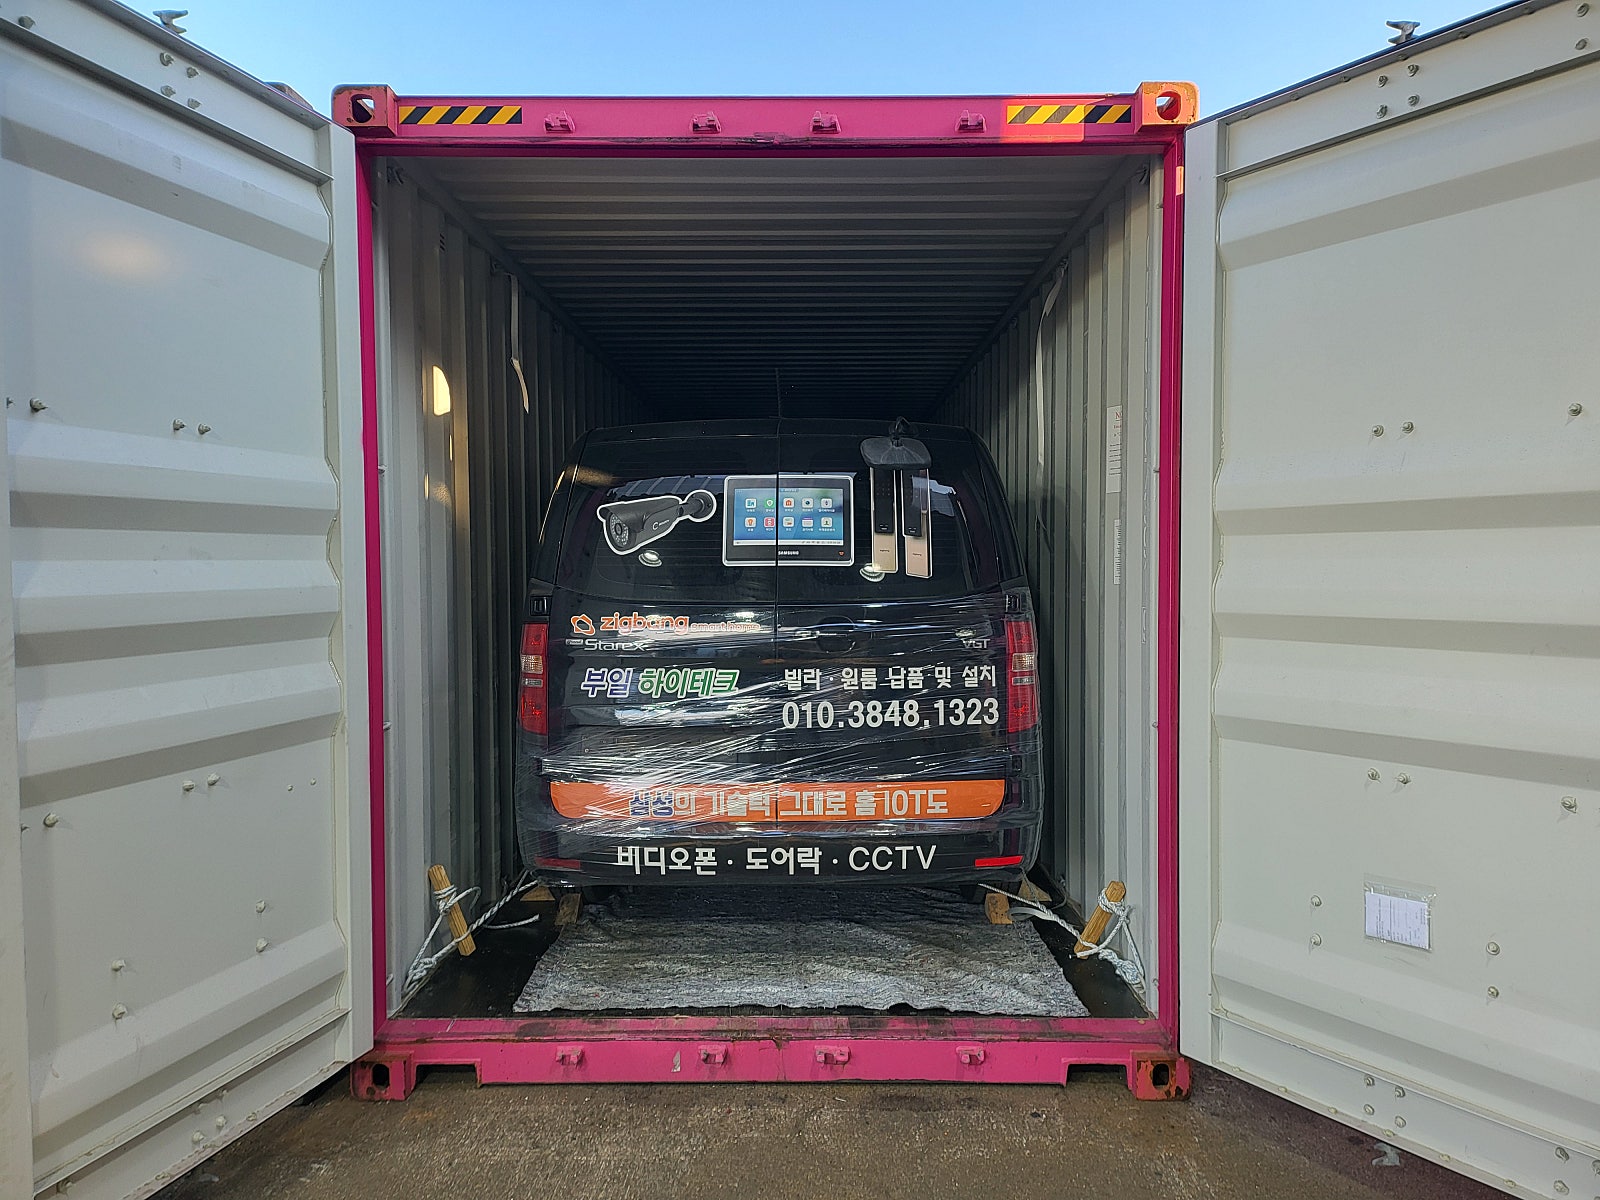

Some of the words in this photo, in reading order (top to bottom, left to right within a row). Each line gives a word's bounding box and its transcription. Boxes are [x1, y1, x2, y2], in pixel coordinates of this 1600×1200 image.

[600, 612, 690, 636] zigbang
[691, 622, 726, 632] smart
[584, 639, 647, 651] Starex
[581, 667, 634, 699] 부일
[638, 667, 741, 699] 하이테크
[784, 668, 822, 691] 빌라
[841, 667, 877, 690] 원룸
[887, 666, 924, 690] 납품
[934, 666, 952, 689] 및
[962, 665, 996, 688] 설치
[782, 697, 1000, 729] 010.3848.1323
[780, 790, 848, 816] 그대로
[617, 845, 717, 876] 비디오폰
[746, 846, 822, 876] 도어락
[849, 844, 937, 872] CCTV
